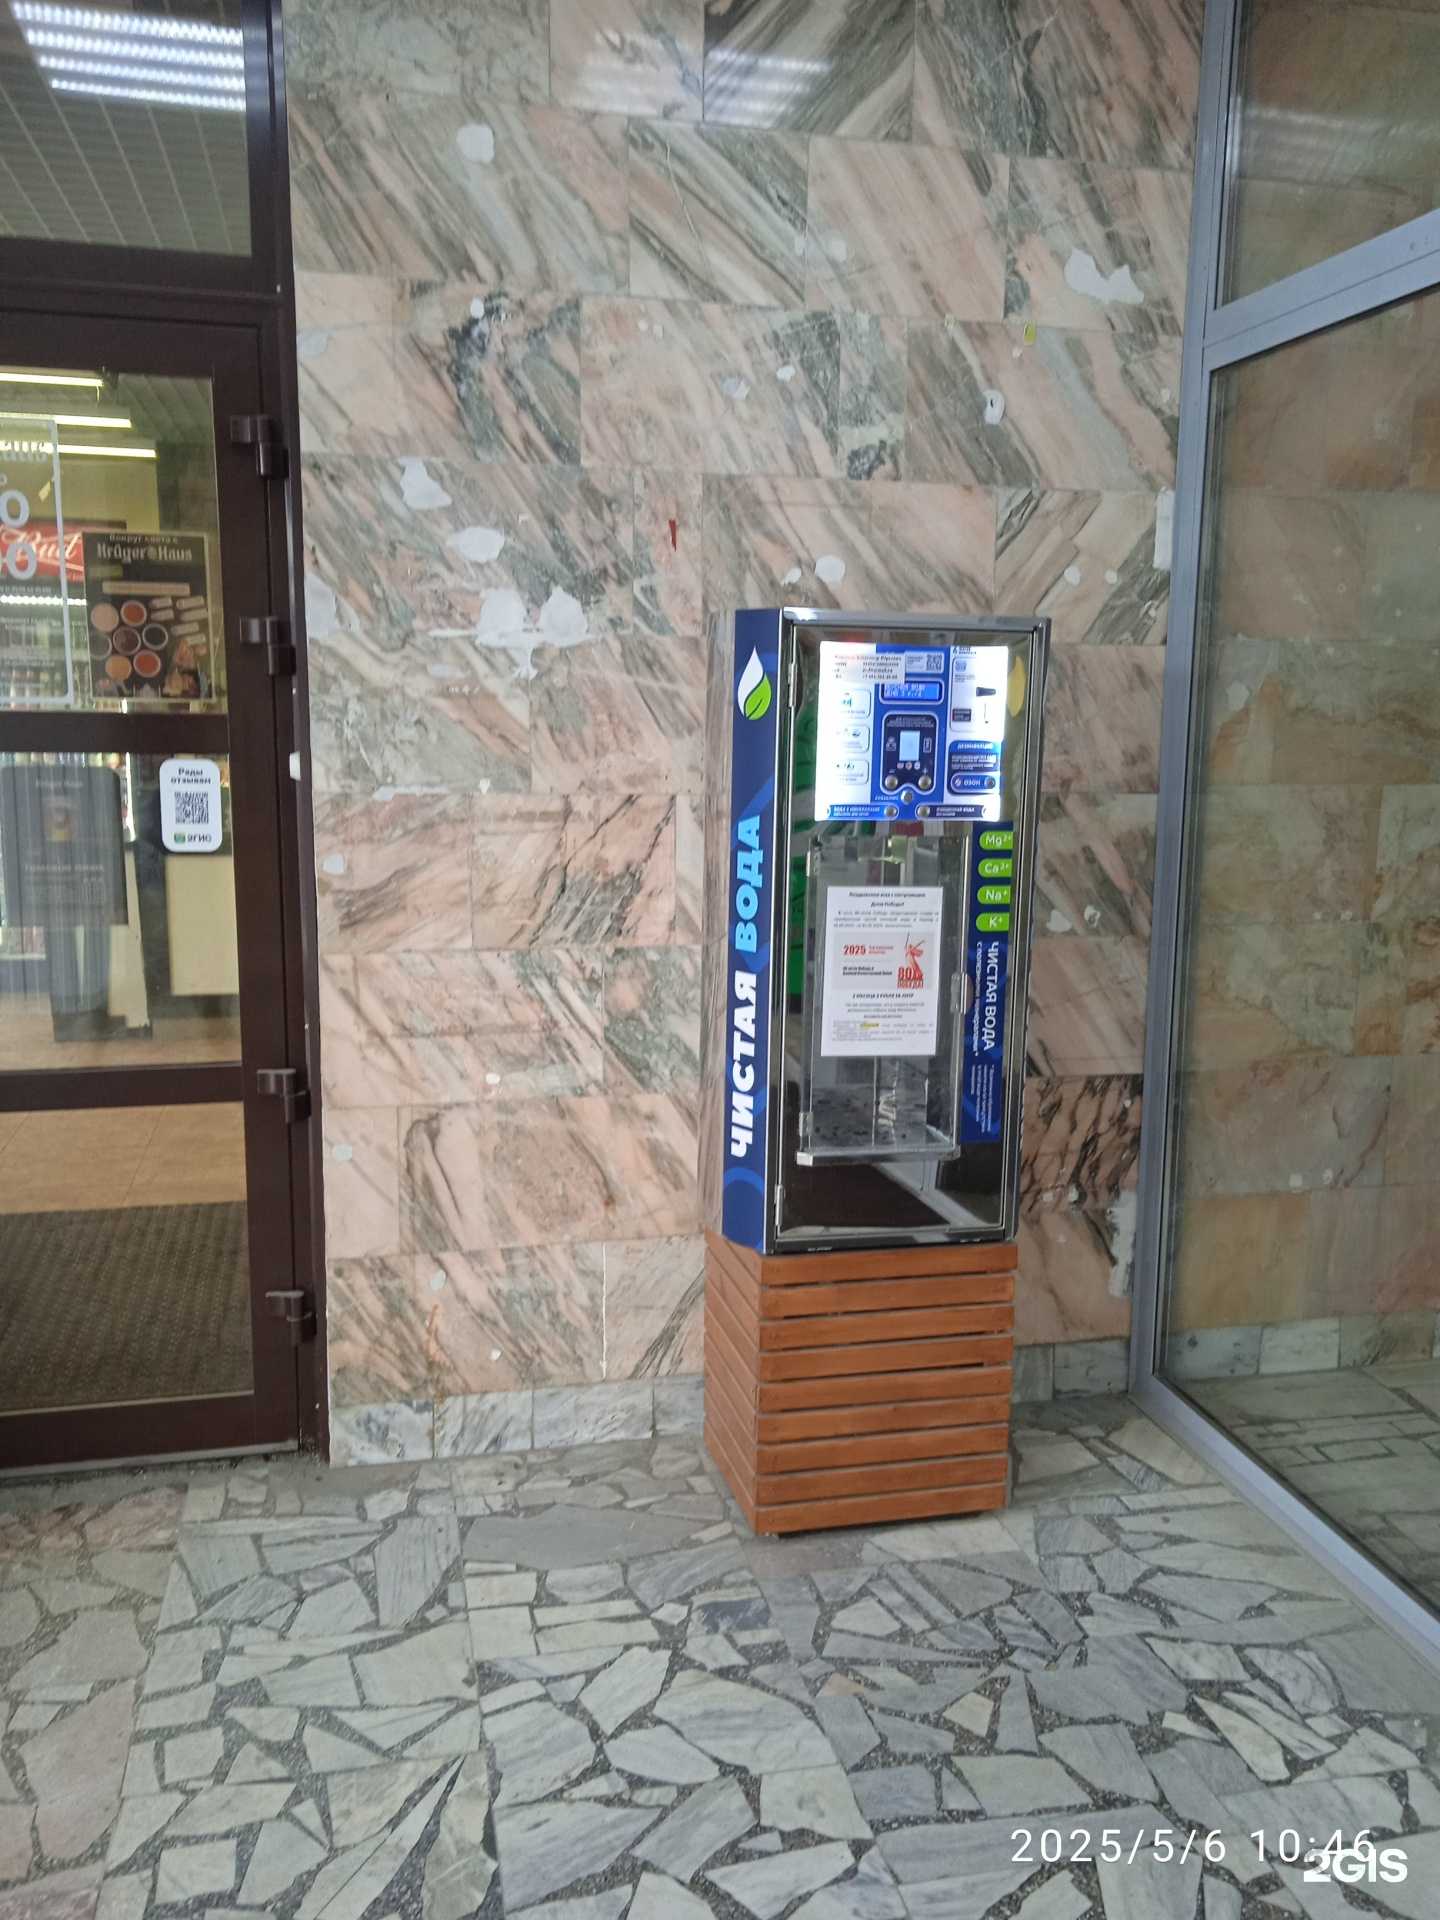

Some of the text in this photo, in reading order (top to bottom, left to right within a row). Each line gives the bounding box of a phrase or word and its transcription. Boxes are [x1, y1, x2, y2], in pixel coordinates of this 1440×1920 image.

[171, 777, 211, 785] отзывам
[178, 768, 203, 776] Рады
[843, 945, 866, 956] 2025
[731, 815, 764, 1157] ЧИСТАЯ ВОДА
[985, 941, 999, 1003] ЧИСТАЯ
[982, 1005, 997, 1051] ВОДА
